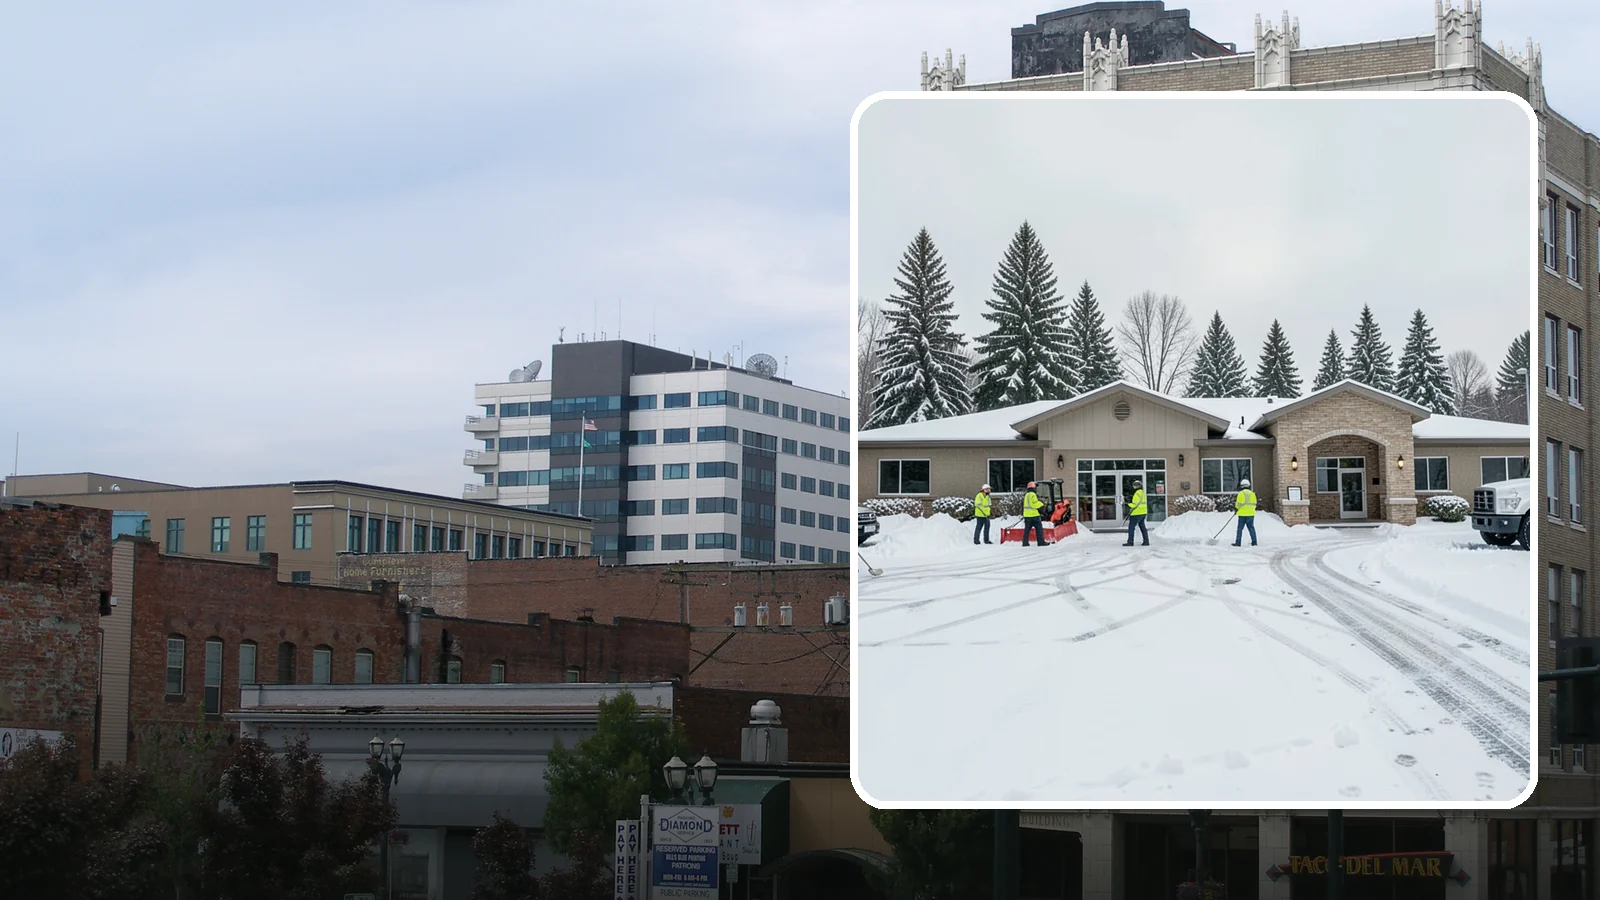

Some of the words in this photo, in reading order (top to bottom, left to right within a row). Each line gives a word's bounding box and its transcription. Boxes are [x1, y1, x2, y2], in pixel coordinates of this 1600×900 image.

[344, 568, 368, 577] Home
[371, 566, 427, 577] Furnishers
[660, 818, 713, 832] DIAMOND
[1022, 815, 1069, 828] BUILDING
[629, 825, 637, 853] PAY
[656, 845, 688, 853] RESERVED
[689, 846, 716, 854] PARKING
[671, 862, 701, 870] PATRONS
[1346, 856, 1385, 876] DEL
[1392, 857, 1443, 877] MAR
[617, 856, 625, 894] HERE
[627, 855, 636, 893] HERE
[661, 889, 682, 897] PUBLIC
[683, 889, 710, 898] PARKING
